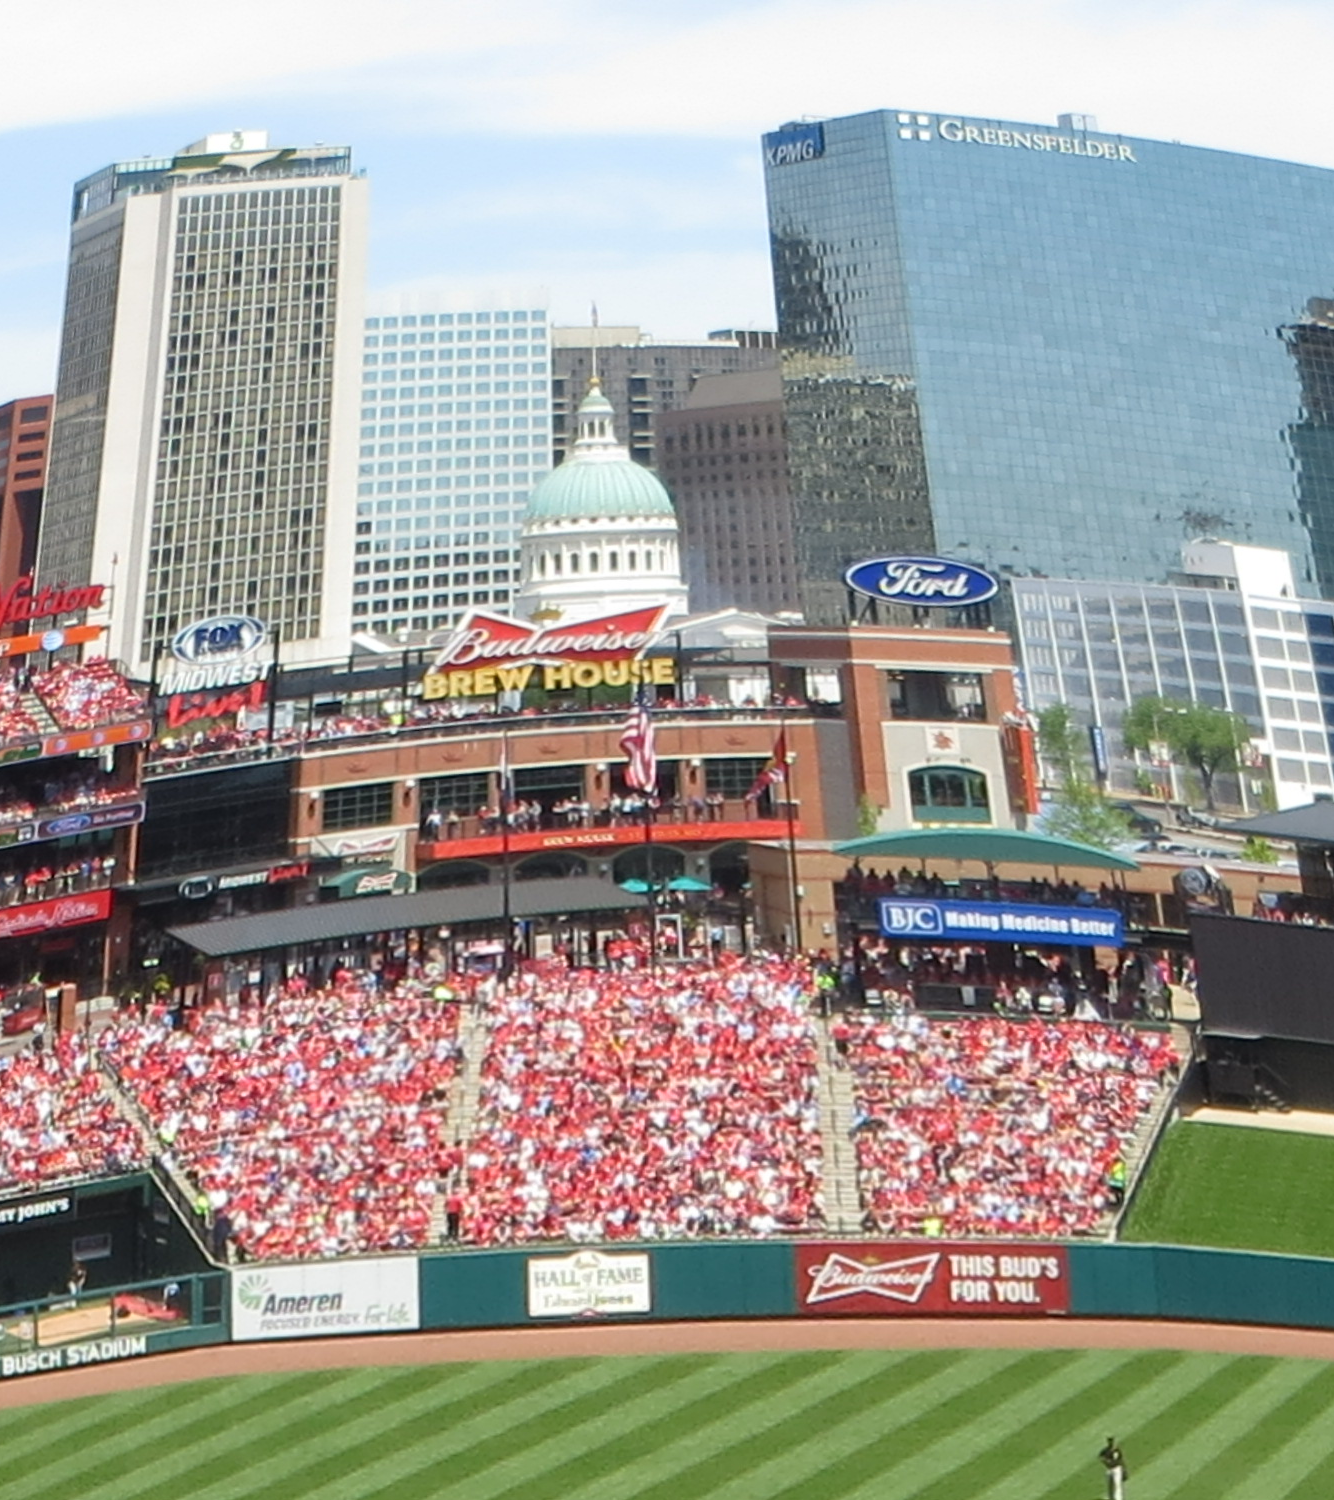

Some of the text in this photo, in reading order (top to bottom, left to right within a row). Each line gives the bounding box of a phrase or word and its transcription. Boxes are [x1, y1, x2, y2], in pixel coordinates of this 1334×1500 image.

[767, 138, 815, 165] KPMG
[938, 119, 1137, 163] GREENSFELDER
[879, 562, 969, 598] Ford
[193, 624, 244, 646] FOX
[428, 625, 671, 668] Budweiser
[159, 660, 274, 696] MIDWEST
[423, 658, 675, 700] BREW HOUSE
[887, 904, 1116, 938] BJC Making Medicine Better
[17, 1198, 69, 1222] JOHN'S
[533, 1267, 645, 1288] HALL FAME
[807, 1263, 935, 1287] Budweiser
[949, 1254, 1059, 1279] THIS BUD'S
[261, 1291, 343, 1316] Ameren
[949, 1280, 1041, 1303] FOR YOU.
[259, 1316, 311, 1331] FOCUSED
[2, 1336, 147, 1376] BUSCH STADIUM
